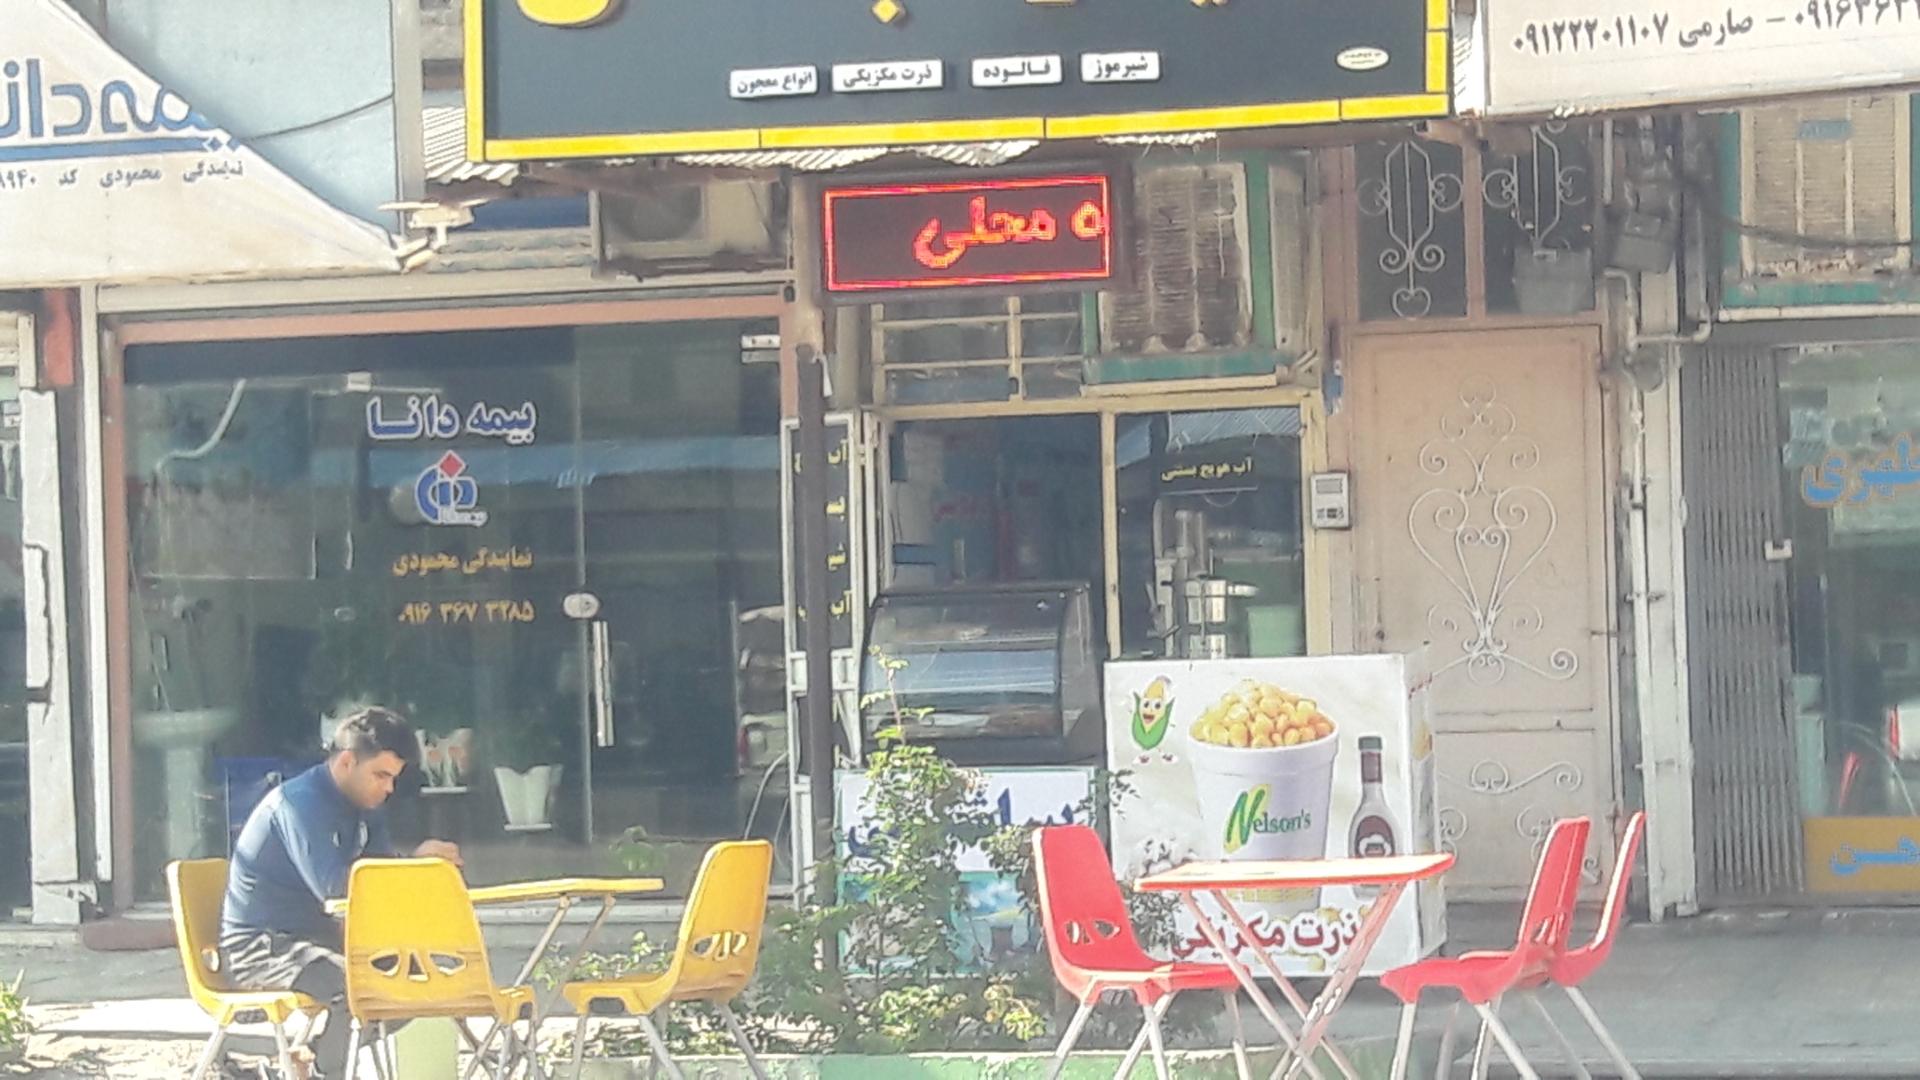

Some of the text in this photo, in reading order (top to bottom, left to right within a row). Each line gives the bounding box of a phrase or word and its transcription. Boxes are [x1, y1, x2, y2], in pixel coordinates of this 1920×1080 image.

[1679, 8, 1753, 47] صارمی
[736, 71, 813, 94] انواع معجون
[843, 64, 933, 87] ذرت مکزیکی
[983, 58, 1051, 83] فالوده
[58, 168, 79, 186] کد
[100, 167, 162, 189] محمودی
[913, 195, 1057, 269] محلی
[366, 394, 537, 444] بیمه دانا
[1233, 456, 1252, 476] آب
[392, 546, 533, 577] نمایندگی محمودی
[1224, 786, 1312, 851] Nelson's
